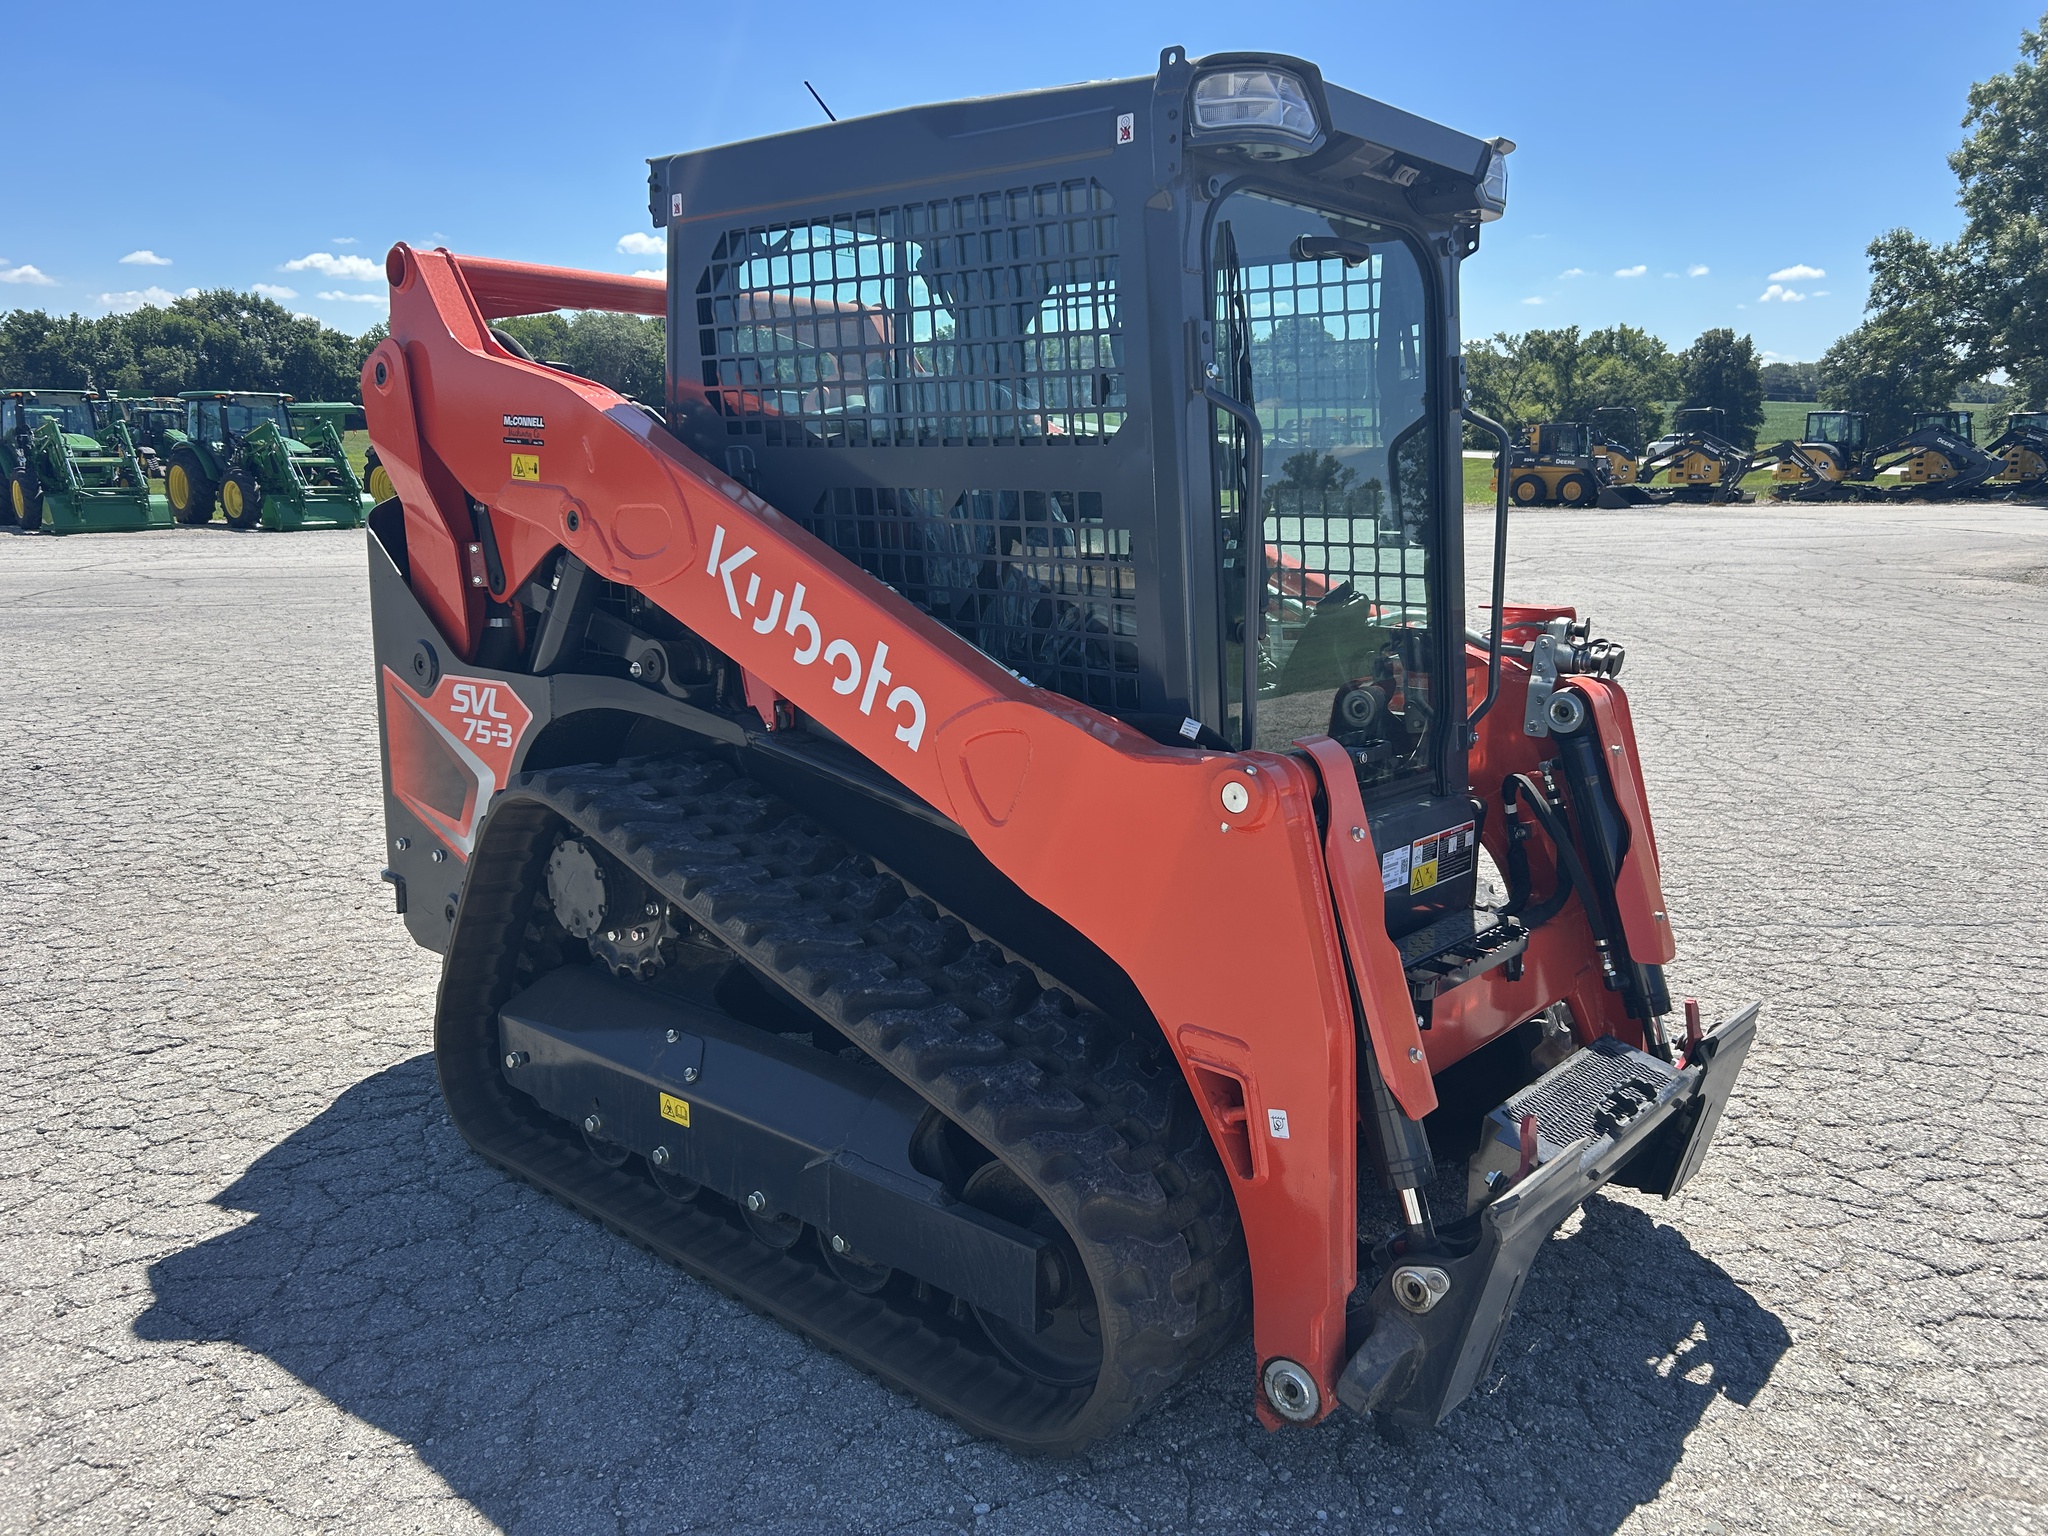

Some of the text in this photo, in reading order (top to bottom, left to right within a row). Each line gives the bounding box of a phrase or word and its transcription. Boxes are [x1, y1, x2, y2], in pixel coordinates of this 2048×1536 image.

[503, 415, 545, 428] McCONNELL
[1703, 443, 1720, 455] DEERE
[1936, 436, 1956, 450] DEERE
[1555, 458, 1576, 466] DEERE
[1789, 454, 1805, 468] DEERE
[706, 524, 927, 753] Kubota
[450, 683, 507, 720] SVL
[462, 717, 513, 748] 75-3
